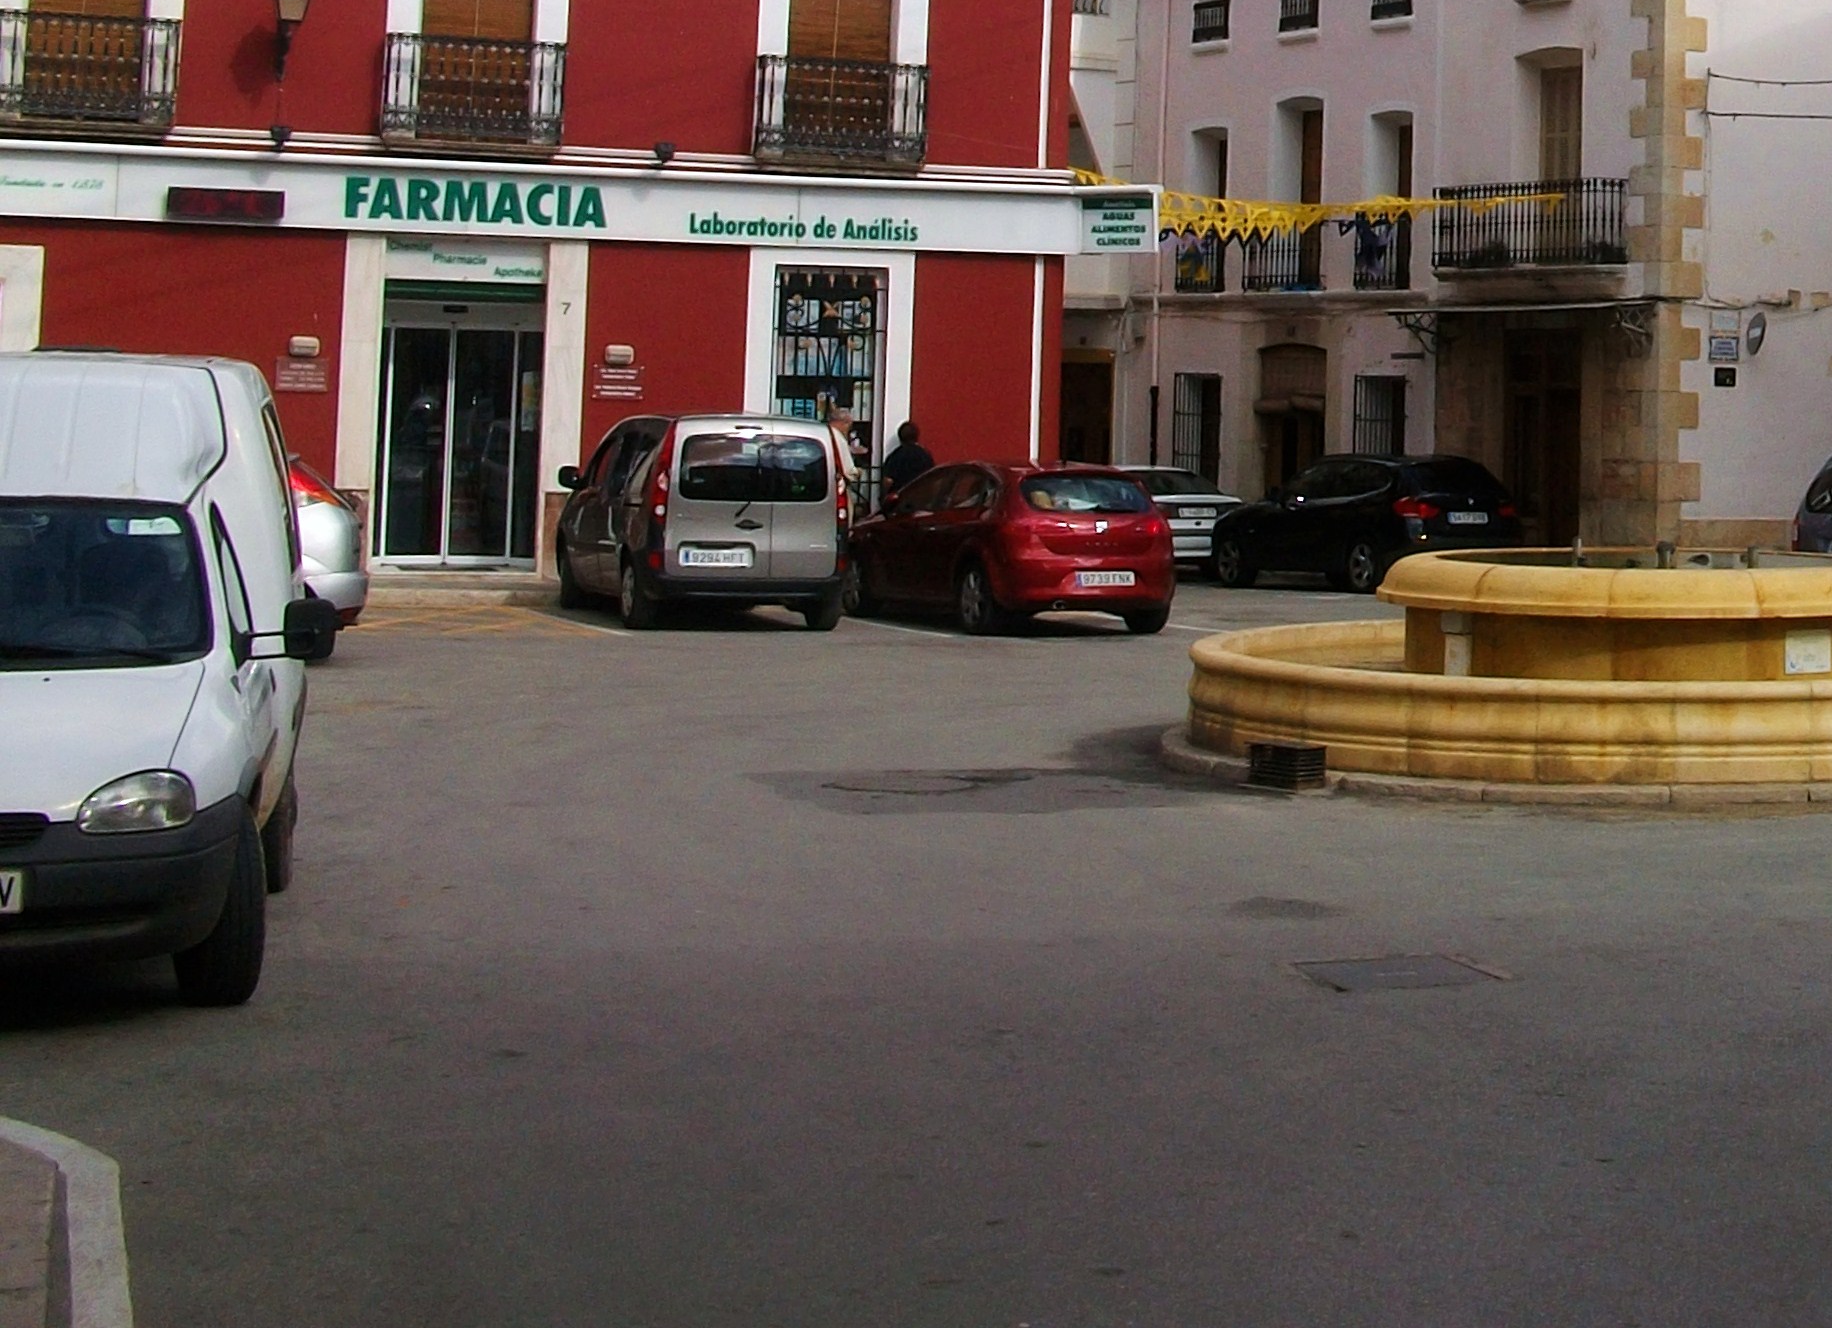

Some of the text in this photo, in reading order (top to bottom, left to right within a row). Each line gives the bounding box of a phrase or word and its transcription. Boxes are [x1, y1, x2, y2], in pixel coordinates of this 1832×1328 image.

[344, 176, 608, 229] FARMACIA
[1102, 212, 1135, 221] AGUAS
[690, 212, 919, 242] Laboratorio de Análisis
[1091, 224, 1146, 234] ALIMENTOS
[432, 252, 488, 266] Pharmacie
[493, 266, 543, 278] Apotheke
[561, 302, 572, 315] 7
